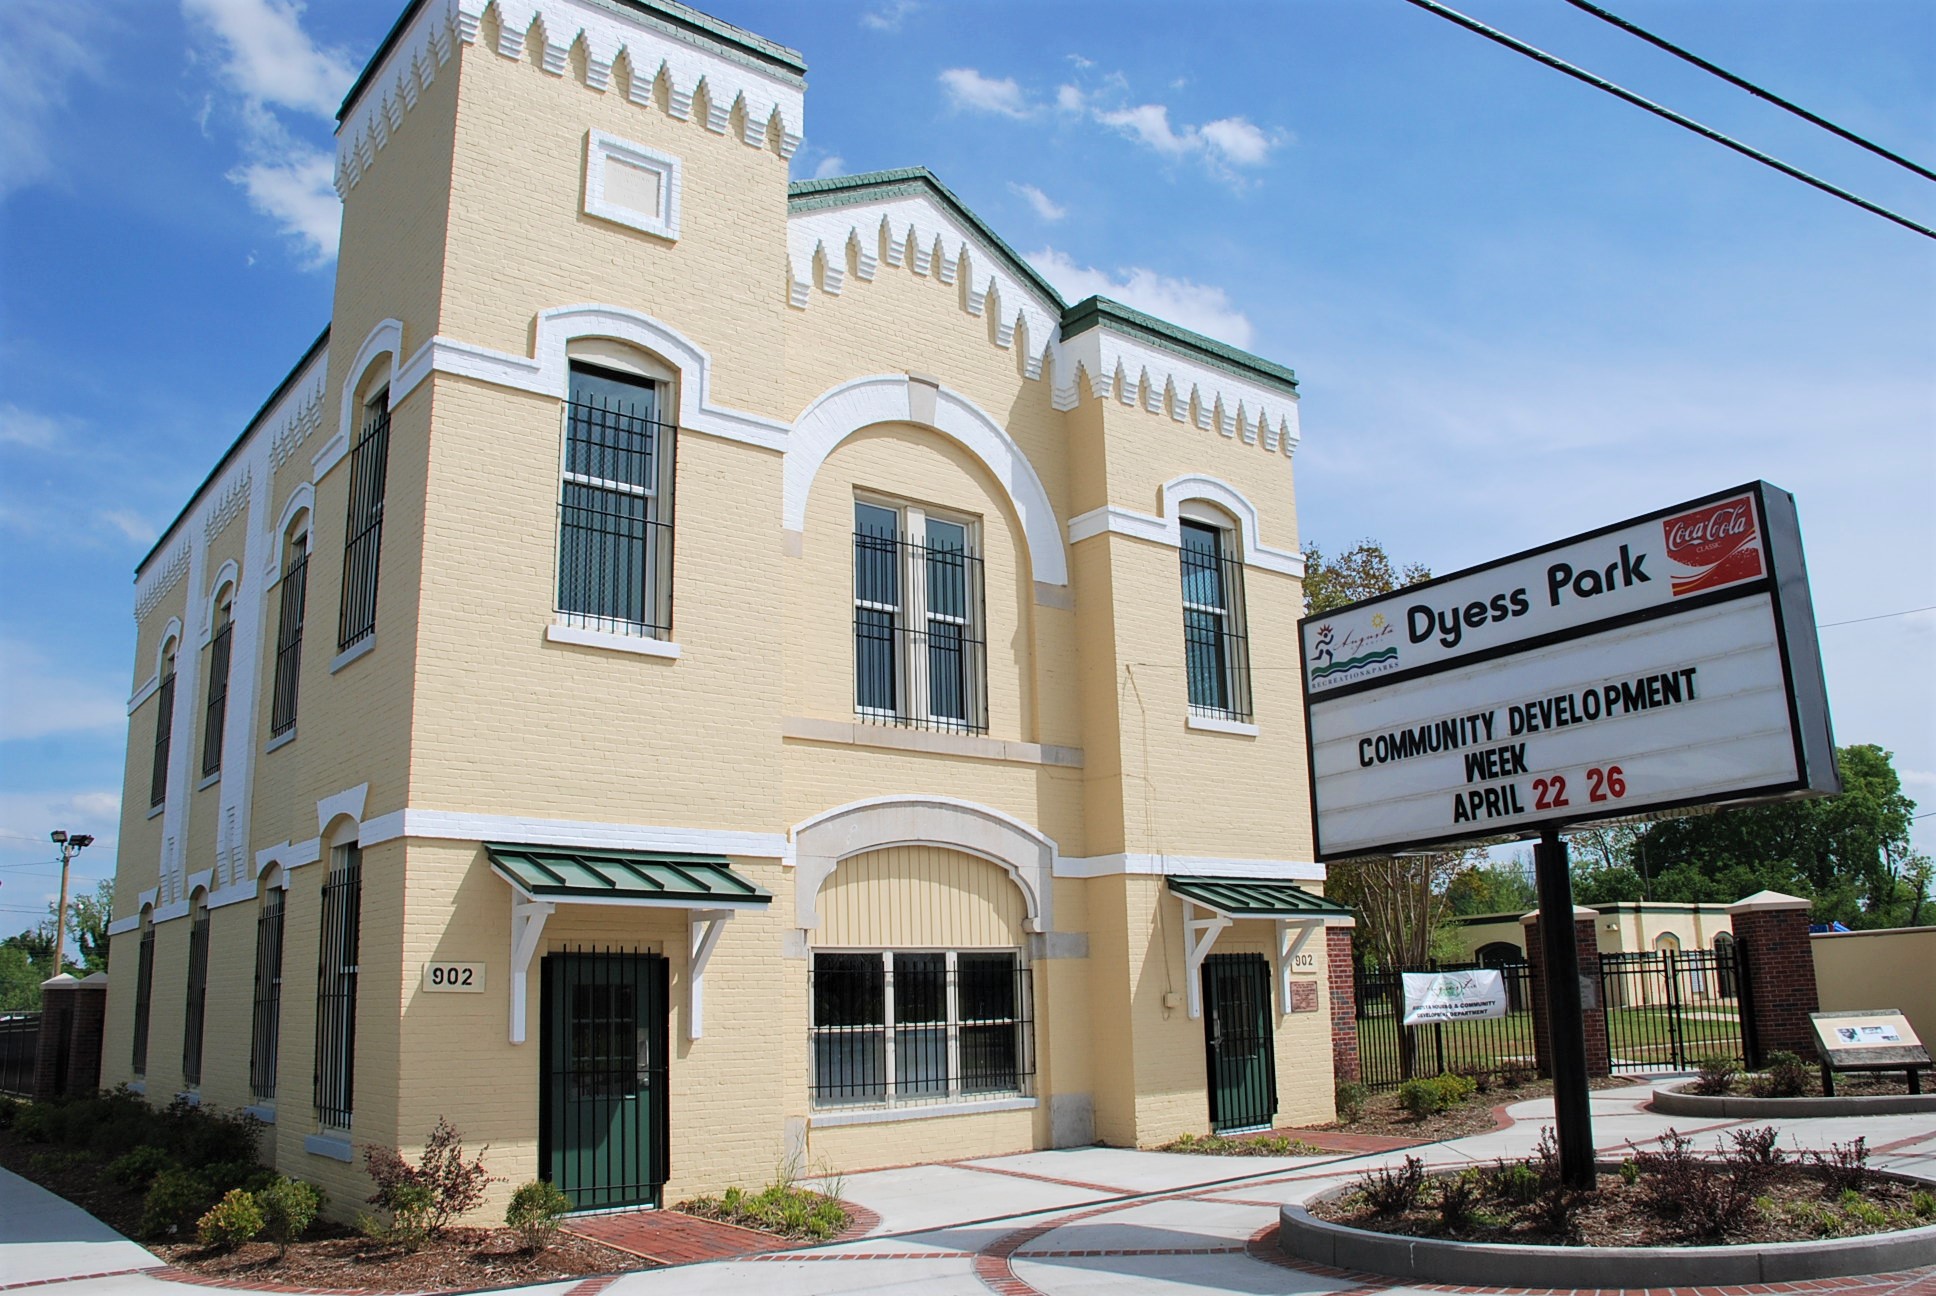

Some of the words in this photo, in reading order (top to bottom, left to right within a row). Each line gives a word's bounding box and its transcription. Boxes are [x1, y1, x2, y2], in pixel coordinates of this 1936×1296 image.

[1668, 504, 1747, 551] Coca-Cola
[1696, 543, 1721, 553] CLASSIC
[1407, 588, 1530, 648] Dyess
[1547, 544, 1652, 607] Park
[1333, 623, 1394, 656] Augusta
[1358, 711, 1495, 767] COMMUNITY
[1508, 667, 1697, 736] DEVELOPMENT
[1465, 743, 1528, 783] WEEK
[1454, 784, 1525, 823] APRIL
[1532, 775, 1570, 811] 22
[1586, 766, 1626, 803] 26
[432, 967, 473, 986] 902
[1295, 955, 1312, 966] 902
[1450, 1009, 1488, 1017] DEPARTMENT
